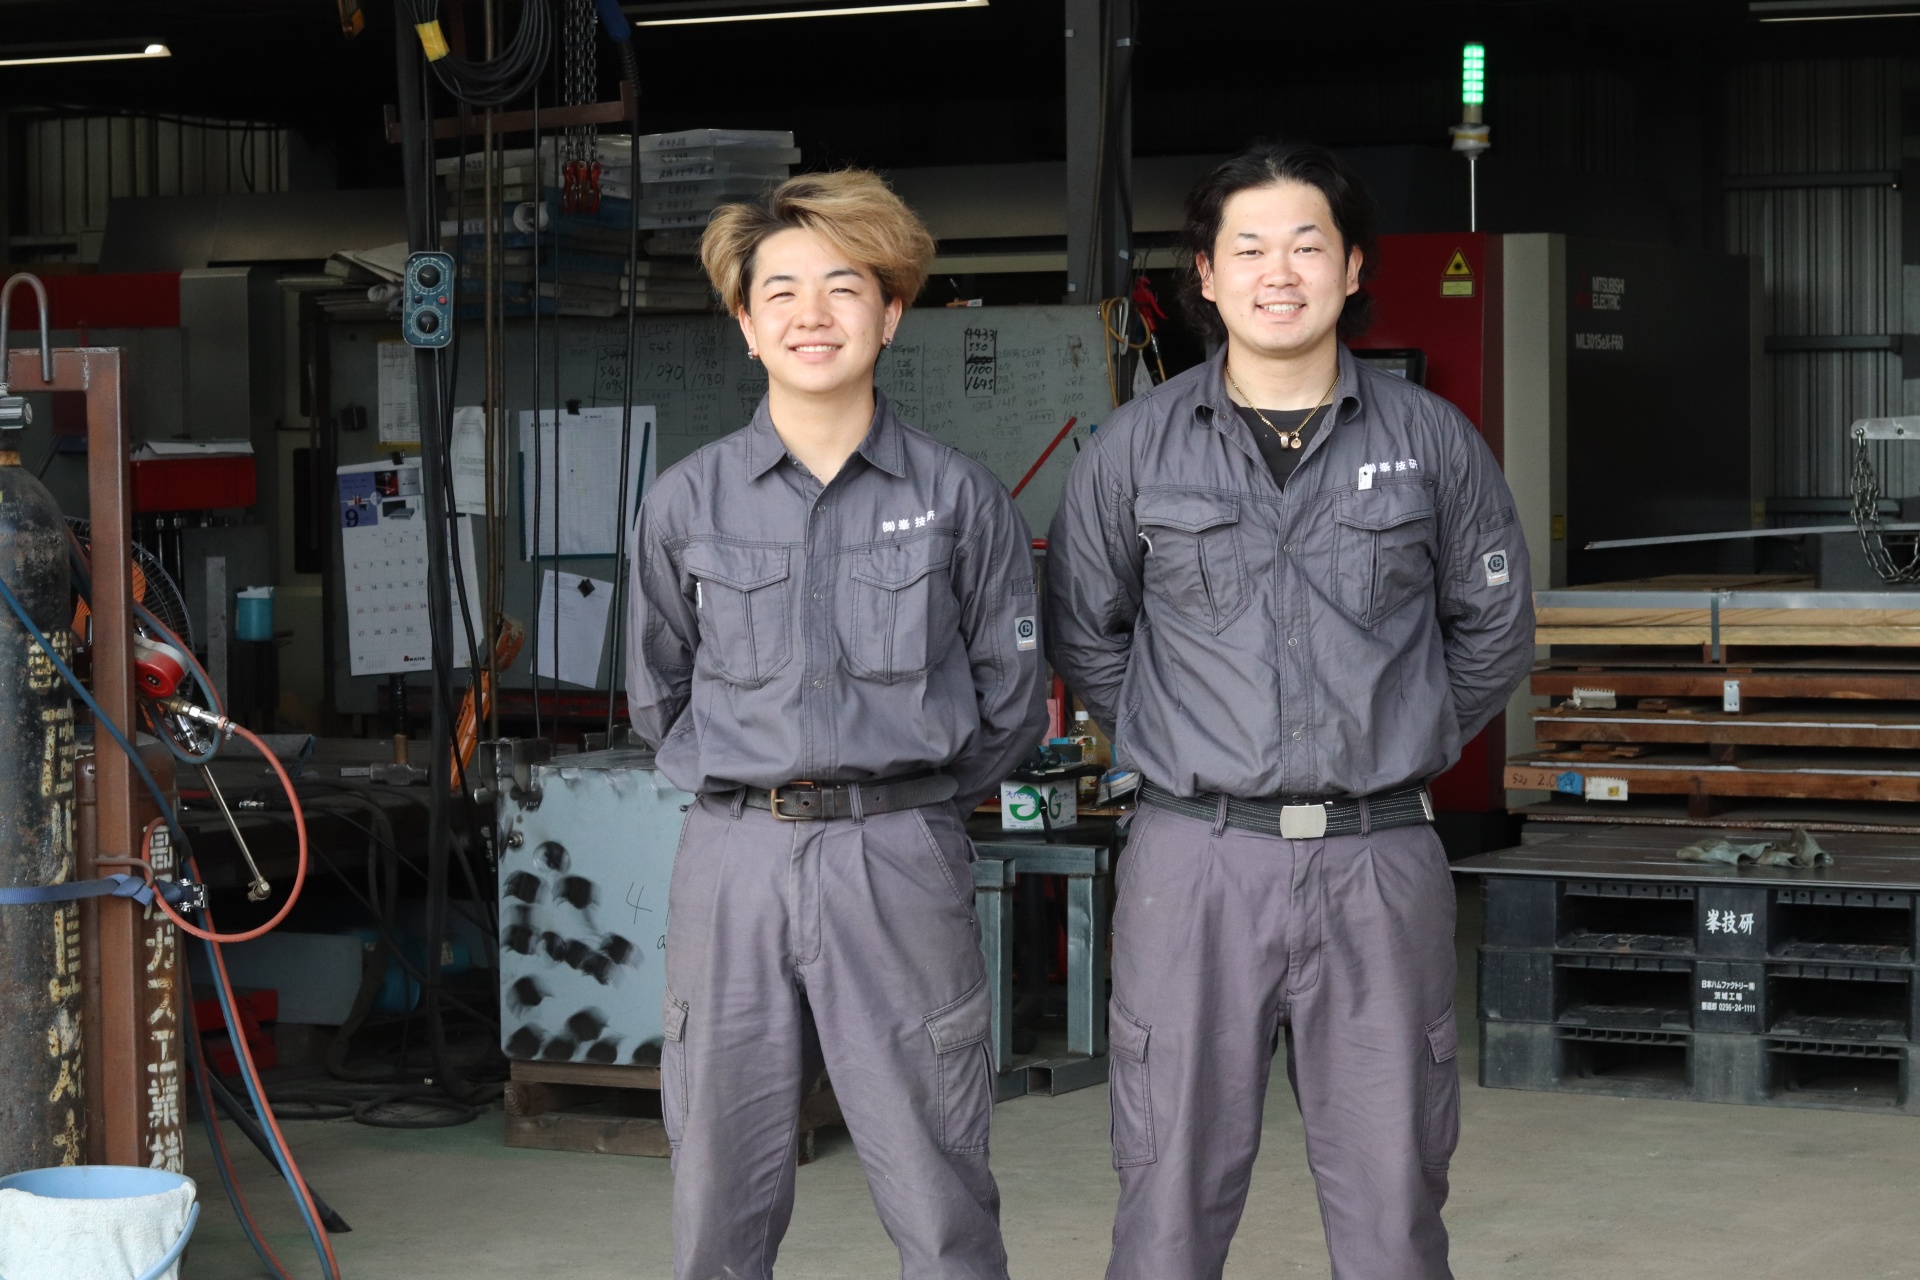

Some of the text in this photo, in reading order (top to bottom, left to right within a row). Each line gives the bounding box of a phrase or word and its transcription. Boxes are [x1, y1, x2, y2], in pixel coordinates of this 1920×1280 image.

[1592, 276, 1625, 294] MITSUBISHI
[1592, 293, 1621, 310] ELECTRIC
[965, 328, 996, 341] 4433
[1575, 332, 1624, 351] ML3015eX-F60
[969, 343, 988, 352] 550
[967, 365, 993, 375] 1100
[345, 508, 359, 527] 9
[626, 881, 653, 925] 4
[1705, 908, 1756, 936] 峯技研
[1718, 1003, 1756, 1013] 0296-24-1111
